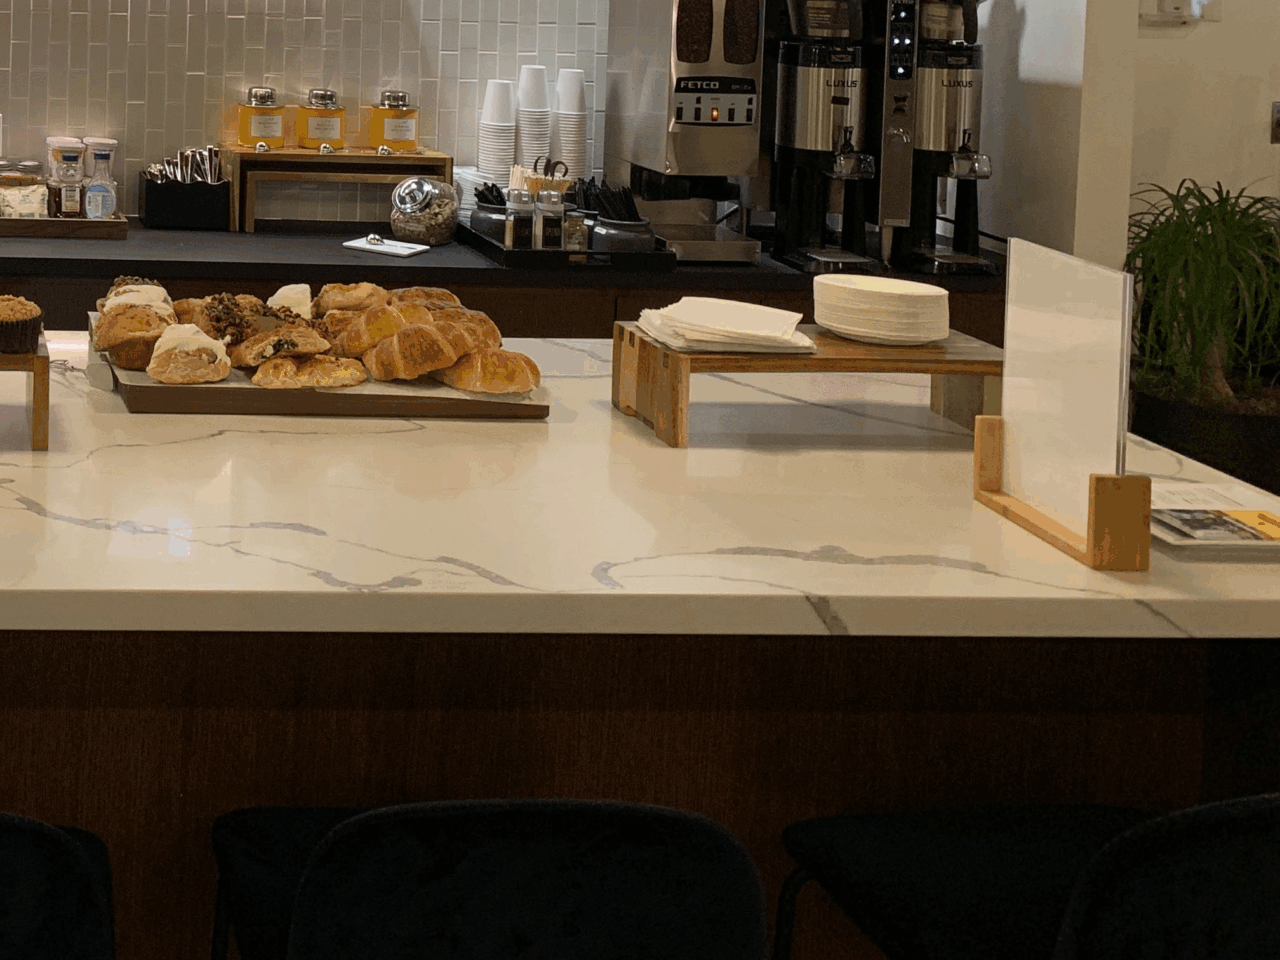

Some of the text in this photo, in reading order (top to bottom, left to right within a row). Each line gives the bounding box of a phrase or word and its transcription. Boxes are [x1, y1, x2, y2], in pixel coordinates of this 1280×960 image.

[680, 81, 719, 89] FETCO
[826, 80, 858, 88] LUXUS
[941, 79, 974, 88] LUXUS
